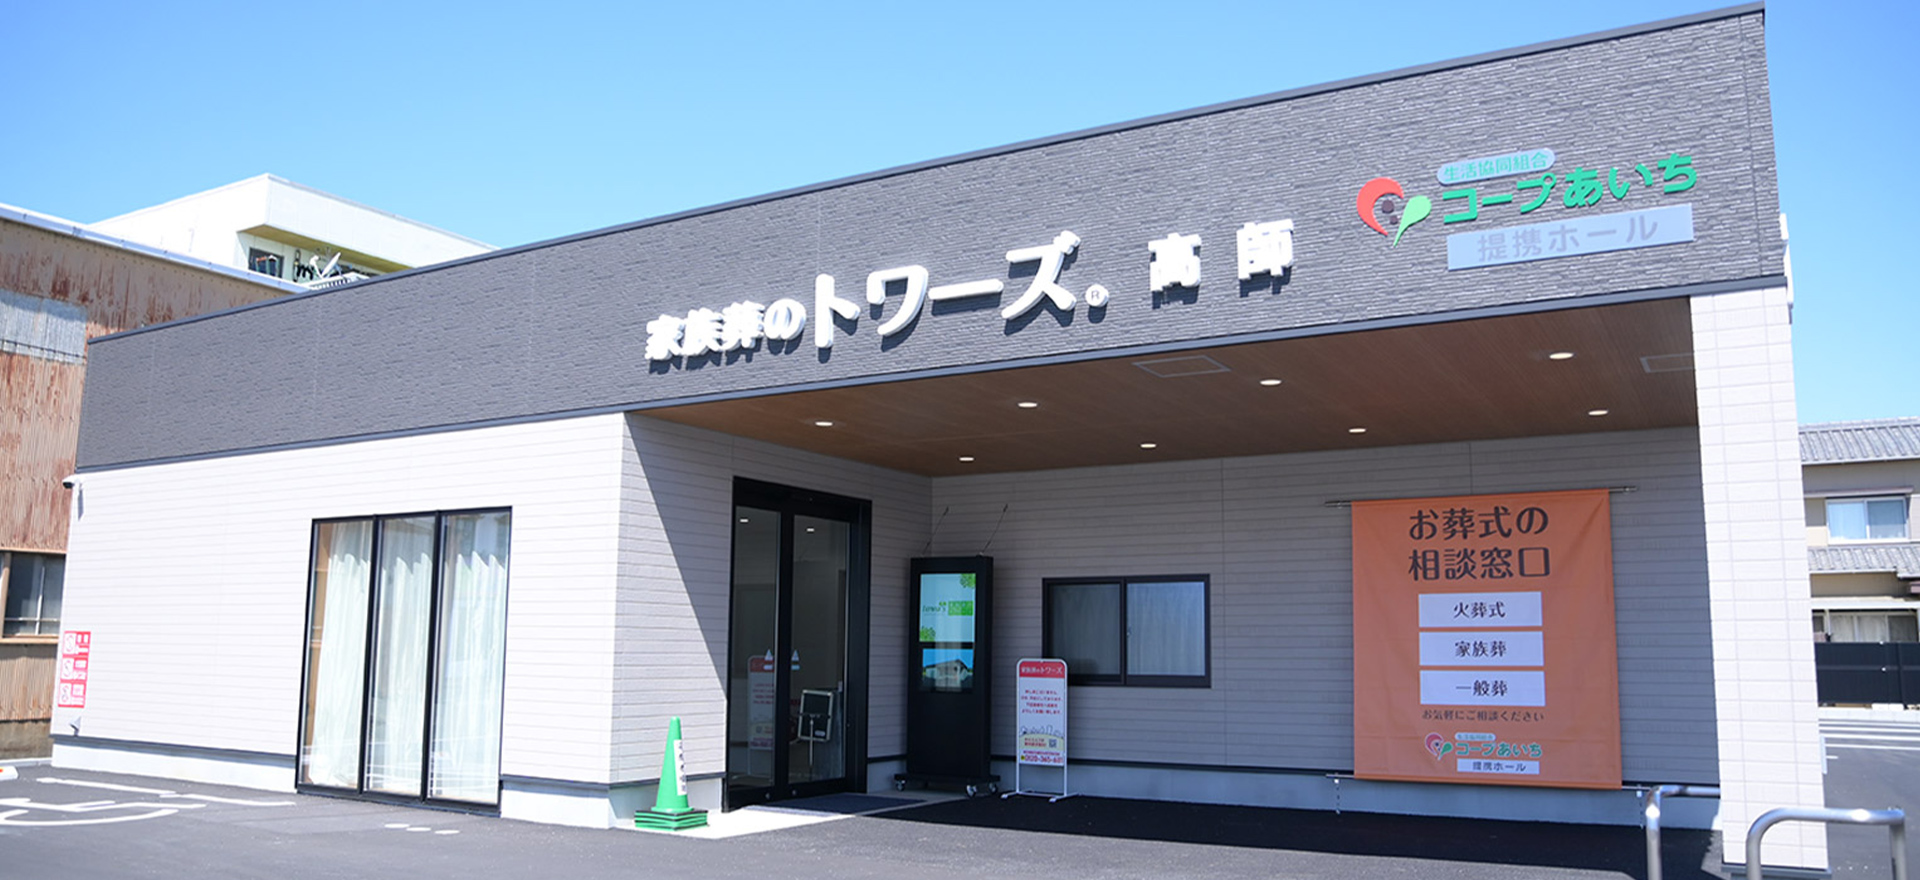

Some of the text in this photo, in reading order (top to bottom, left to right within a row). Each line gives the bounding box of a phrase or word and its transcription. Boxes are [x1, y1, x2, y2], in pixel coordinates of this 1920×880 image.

[1442, 153, 1697, 224] コープあいち
[1477, 215, 1658, 262] 提携ホール
[1409, 506, 1549, 540] お葬式の
[1408, 547, 1550, 581] 相談窓口
[1453, 602, 1506, 619] 火葬式
[1455, 641, 1507, 658] 家族葬
[1456, 680, 1508, 697] 一般葬
[1422, 709, 1545, 722] お気軽にご相談ください
[1455, 742, 1542, 757] コープあいち
